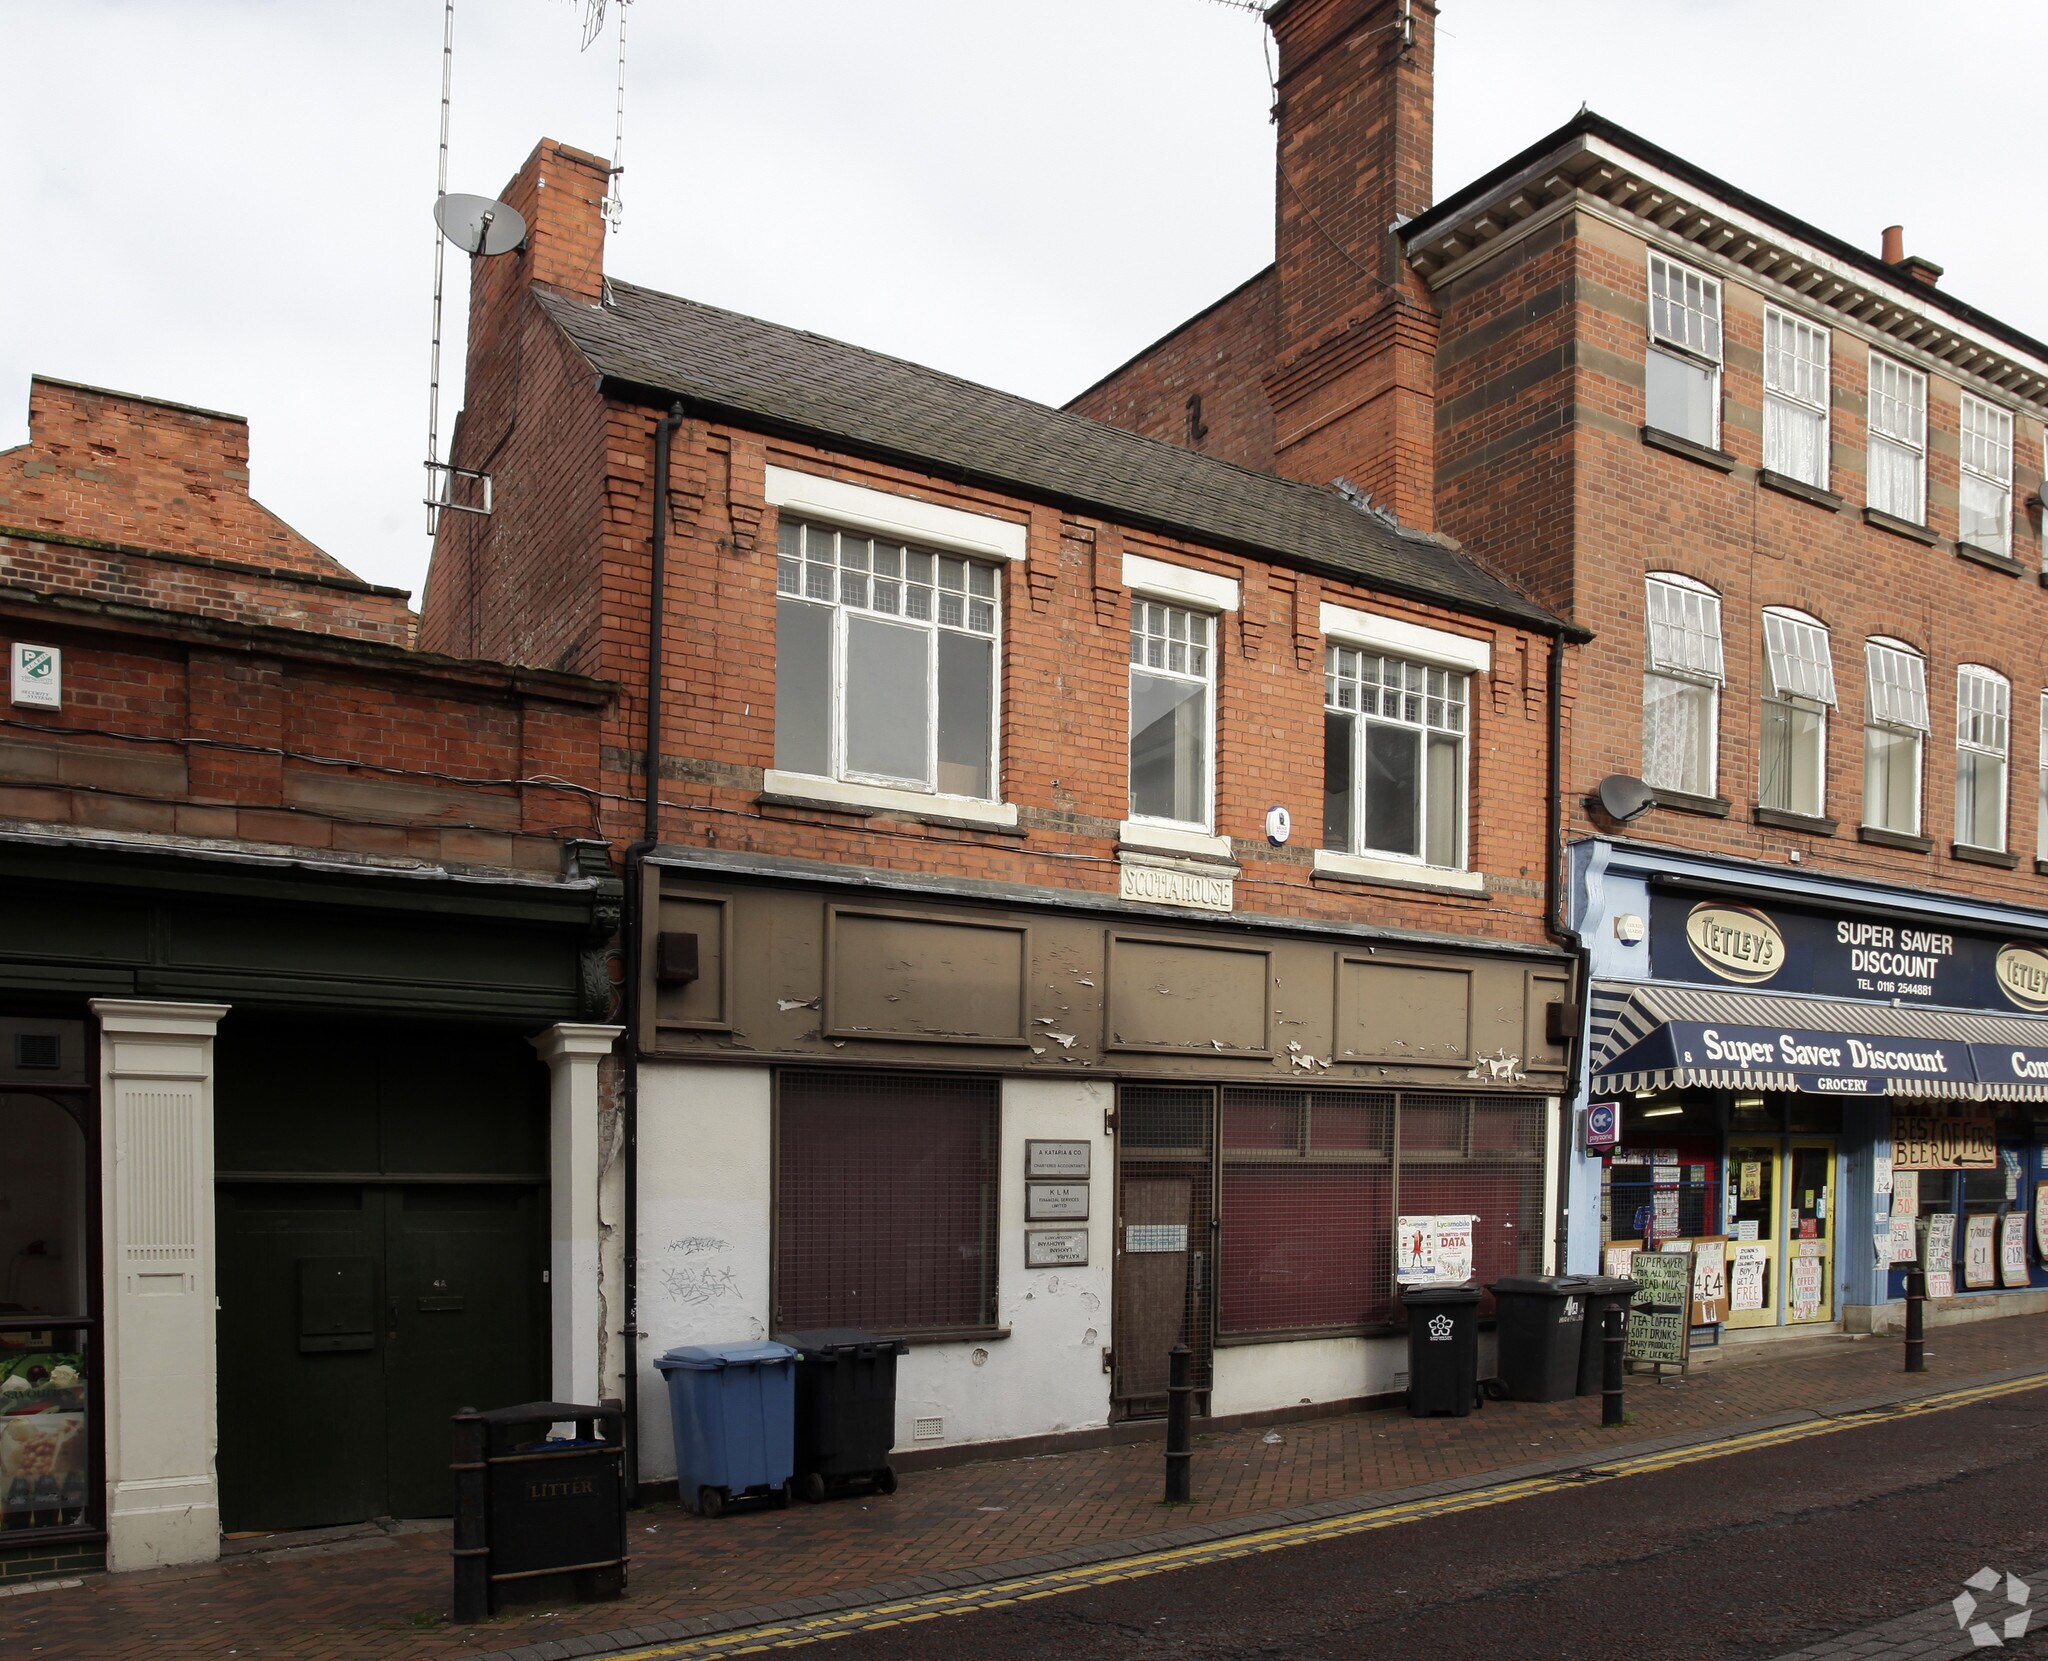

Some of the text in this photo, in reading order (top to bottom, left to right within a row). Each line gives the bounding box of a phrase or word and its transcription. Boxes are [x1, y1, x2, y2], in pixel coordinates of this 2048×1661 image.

[1125, 868, 1231, 906] SCOTIA HOUSE
[1702, 916, 1774, 965] TETLEY'S
[1837, 921, 1953, 955] SUPER SAVER
[1851, 949, 1938, 978] DISCOUNT
[1877, 981, 1895, 993] 0116
[1897, 982, 1932, 996] 2544881
[1684, 1051, 1693, 1062] 8
[1703, 1029, 1774, 1068] Super
[1779, 1034, 1841, 1067] Saver
[1846, 1039, 1948, 1073] Discount
[1817, 1078, 1868, 1092] GROCERY
[1589, 1134, 1613, 1142] payzone
[1894, 1118, 1994, 1162] BEST OFFERS
[1894, 1142, 1940, 1166] BEER
[1437, 1220, 1470, 1228] Lycamobile
[1441, 1237, 1466, 1247] DATA
[1930, 1238, 1939, 1248] BUY
[1929, 1248, 1939, 1257] GET
[1974, 1248, 1985, 1264] £1
[1636, 1257, 1683, 1270] SUPER SAVER
[1799, 1258, 1812, 1267] NEW
[1740, 1267, 1751, 1275] BUY
[1695, 1272, 1723, 1297] 4 £4
[1737, 1274, 1754, 1286] GET 2
[1797, 1277, 1815, 1286] OFFER
[1736, 1286, 1758, 1300] FREE
[1930, 1282, 1952, 1295] OFFER
[1694, 1293, 1705, 1301] FOR
[531, 1481, 593, 1498] LITTER
